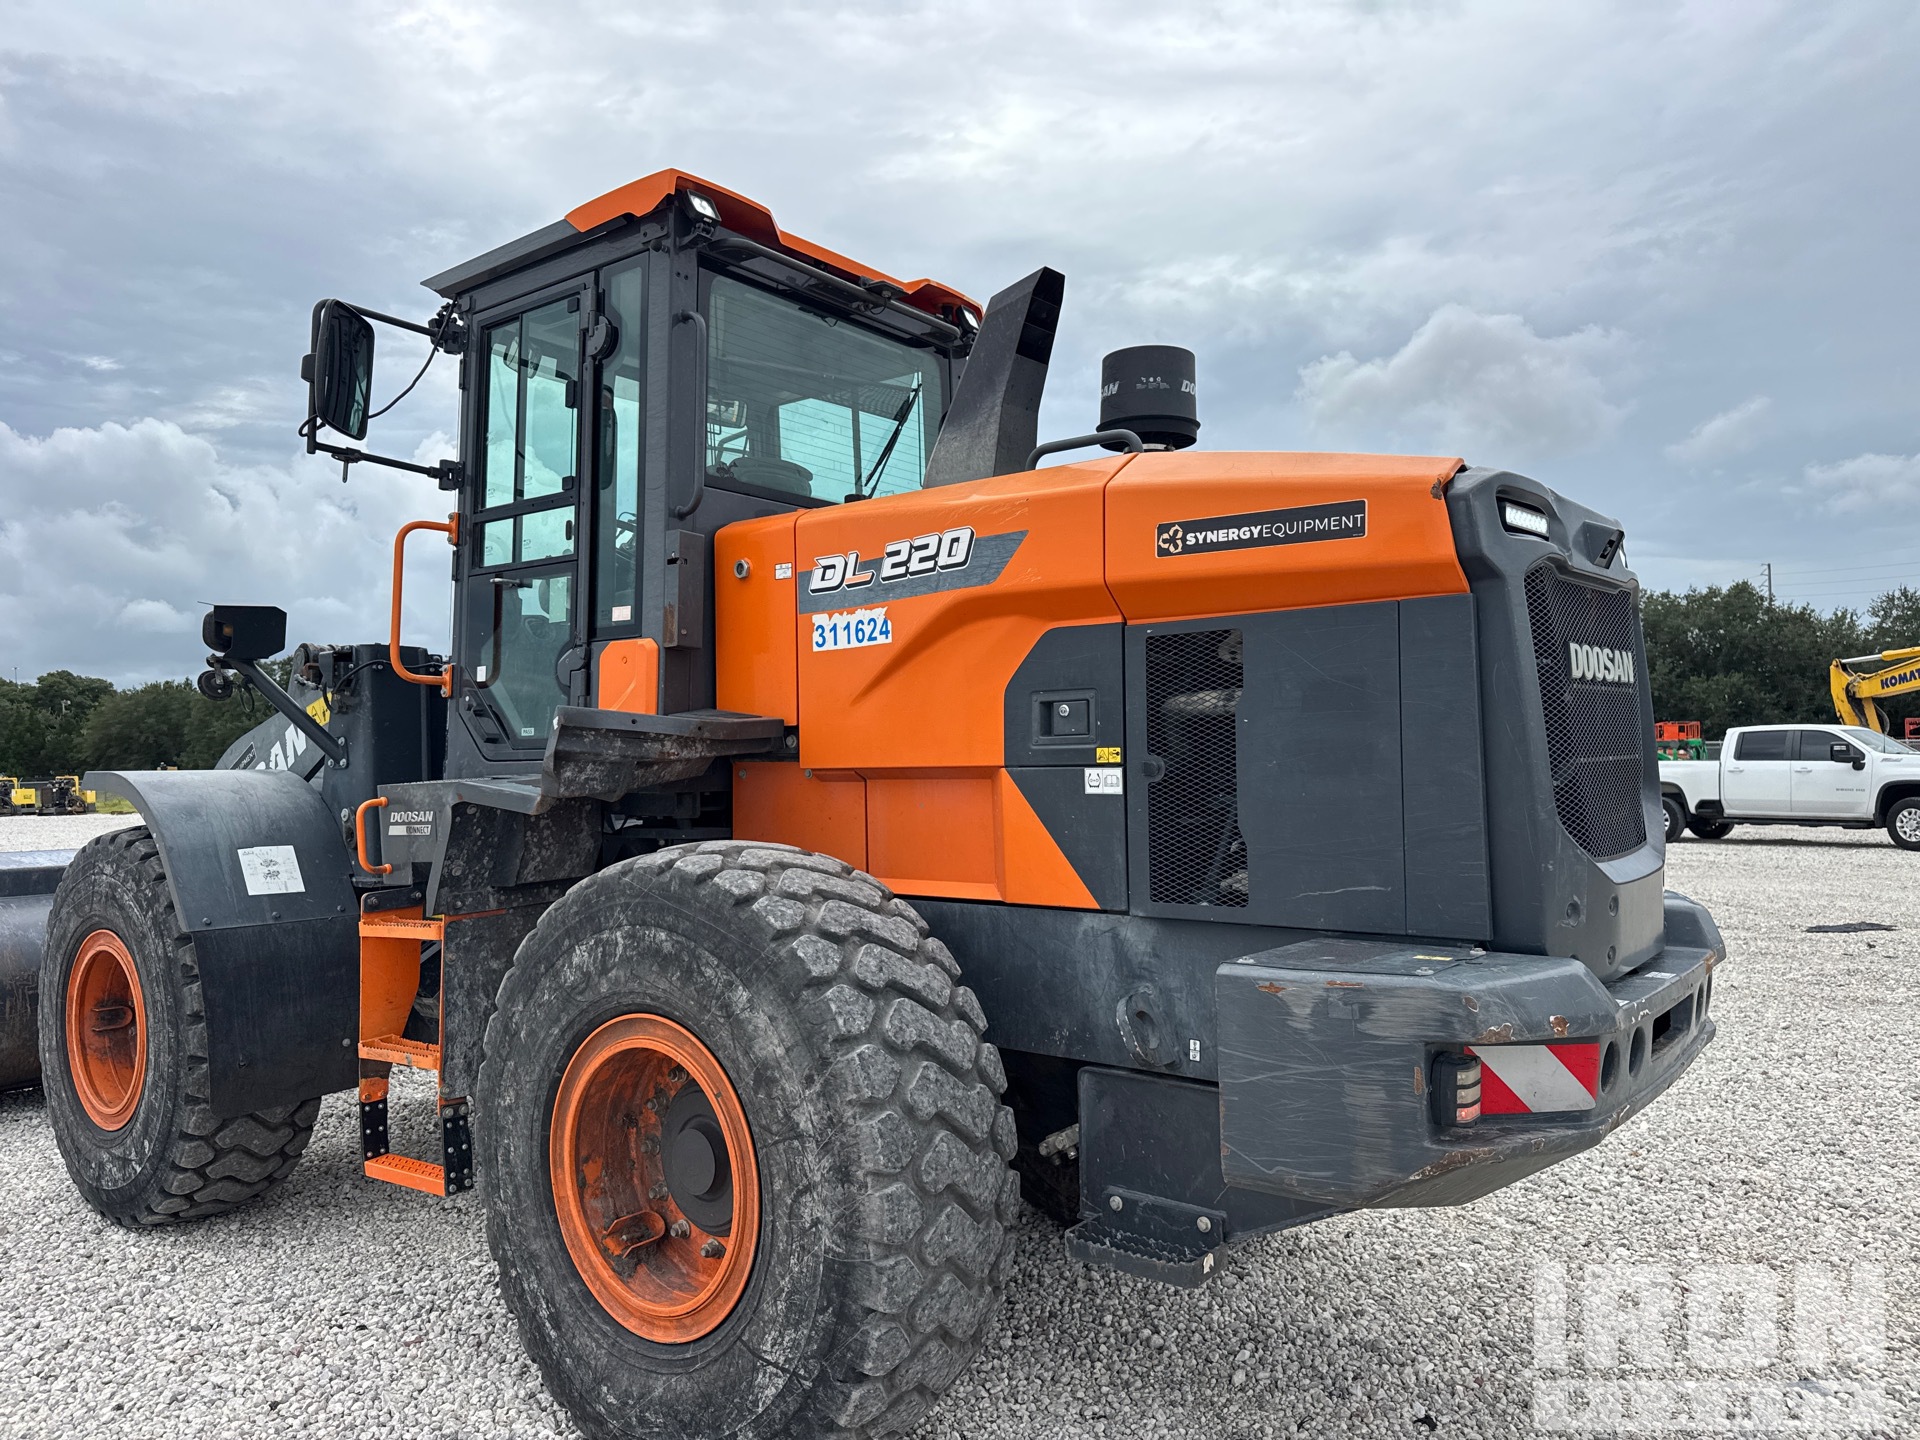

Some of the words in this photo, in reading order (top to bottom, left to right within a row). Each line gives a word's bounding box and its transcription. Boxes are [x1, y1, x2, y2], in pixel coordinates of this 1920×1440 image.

[809, 551, 876, 595] DL
[880, 526, 976, 583] 220
[814, 617, 891, 649] 311624
[1569, 642, 1635, 684] DOOSAN
[390, 811, 433, 822] DOOSAN
[405, 826, 429, 834] CONNECT
